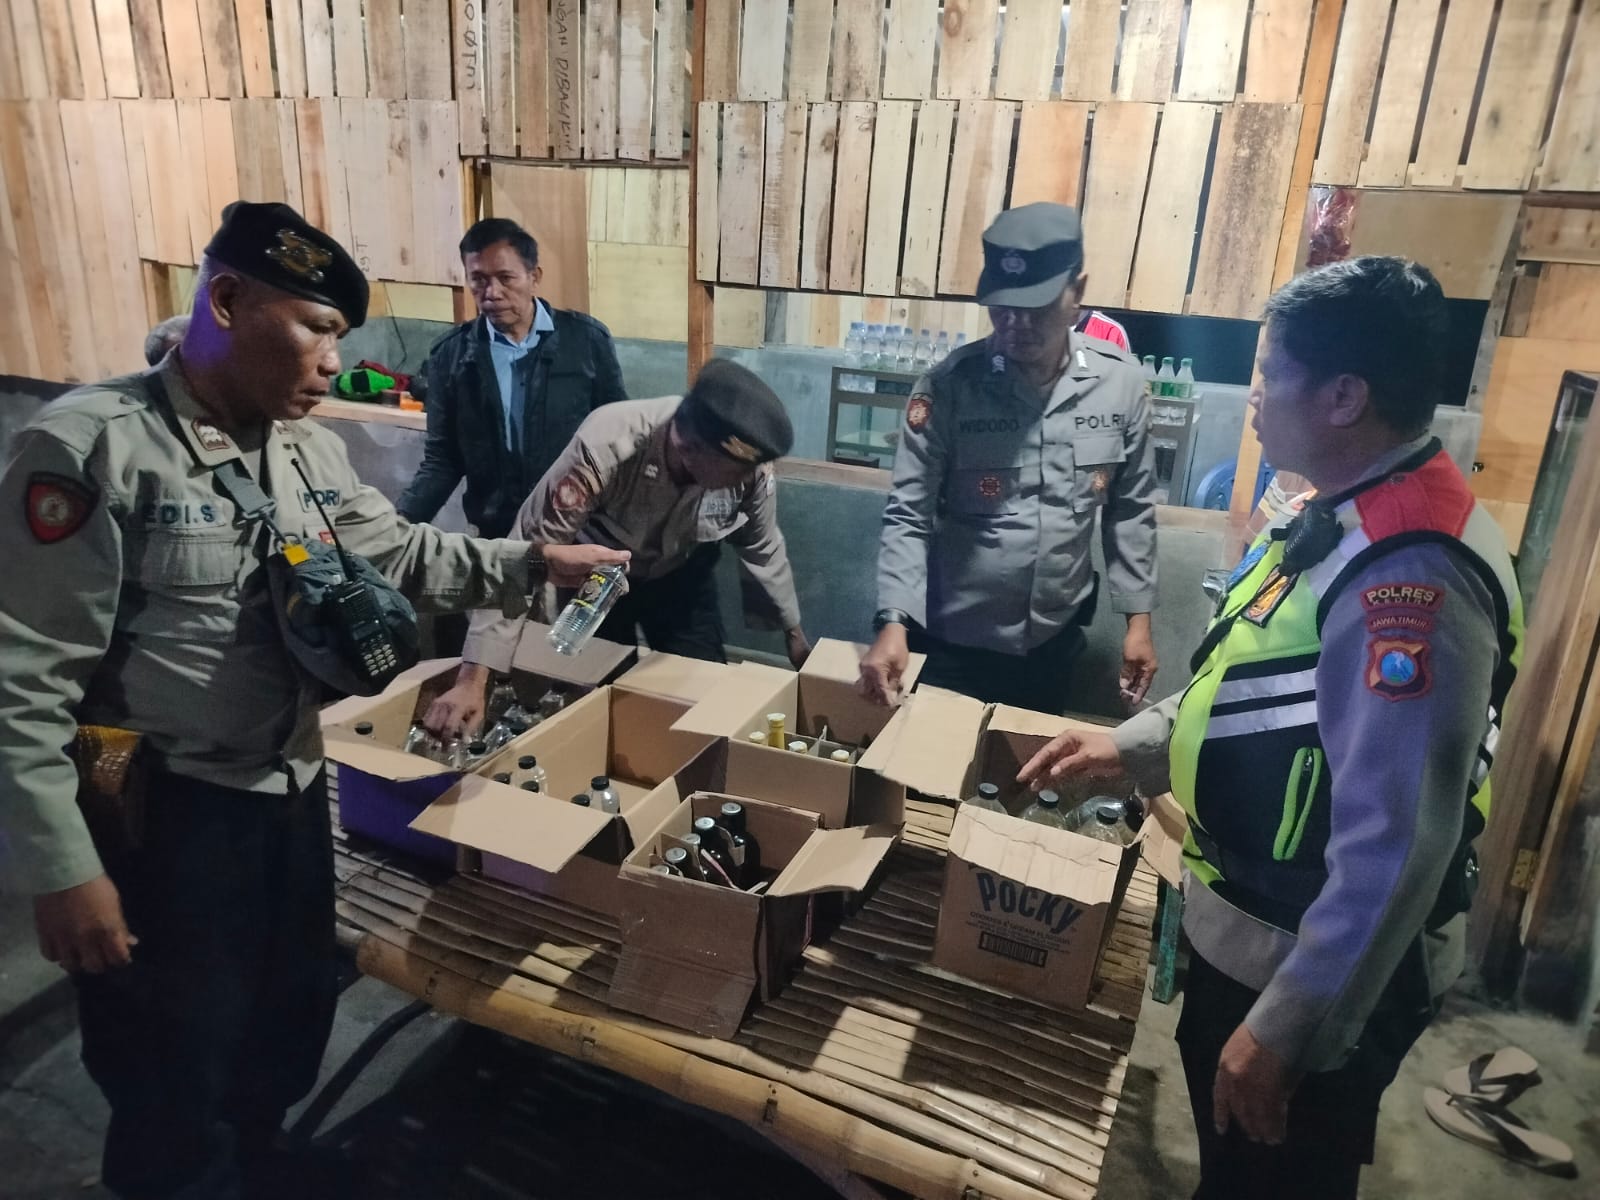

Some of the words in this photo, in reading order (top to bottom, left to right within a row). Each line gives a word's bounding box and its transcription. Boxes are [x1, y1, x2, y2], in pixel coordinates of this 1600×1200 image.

[959, 418, 1021, 433] WIDODO
[1366, 586, 1436, 603] POLRES
[1372, 616, 1397, 628] JAWA
[1398, 616, 1428, 629] TIMUR
[976, 872, 1083, 934] POCKY
